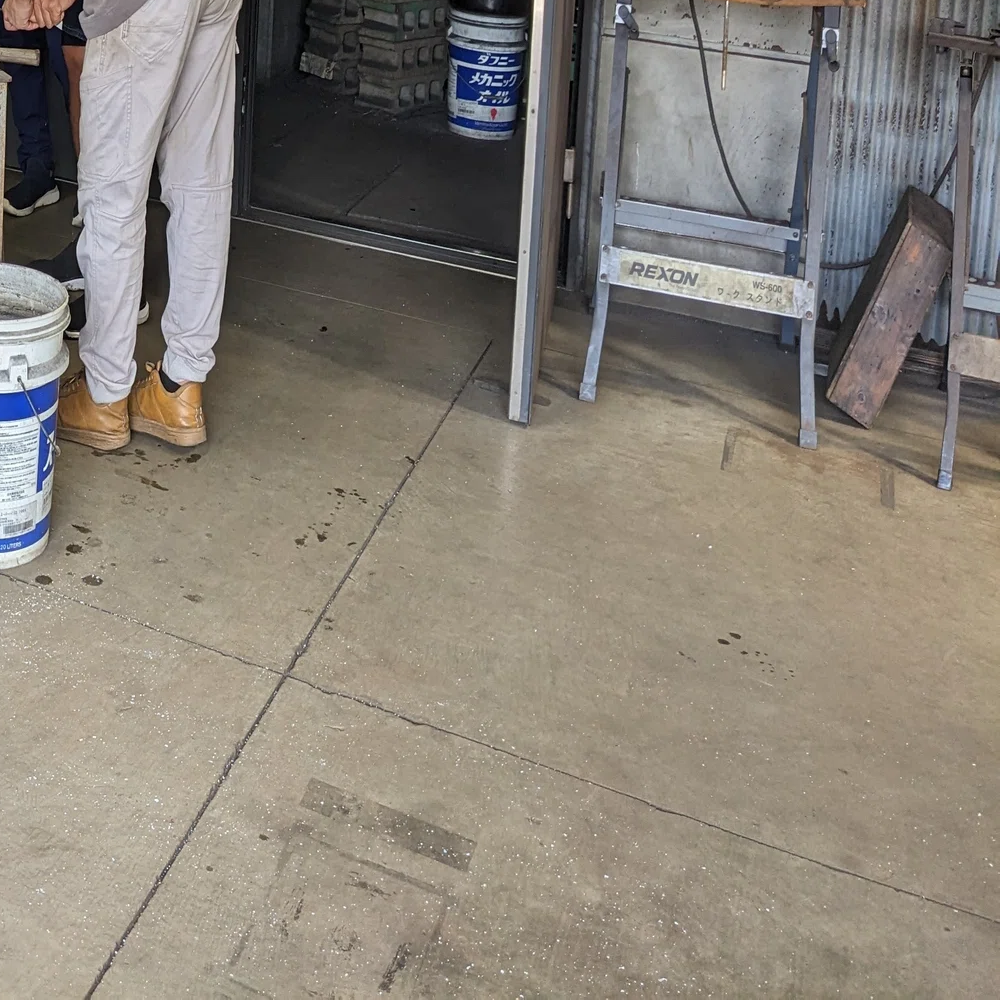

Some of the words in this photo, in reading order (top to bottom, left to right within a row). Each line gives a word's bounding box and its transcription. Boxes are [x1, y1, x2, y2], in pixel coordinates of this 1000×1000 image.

[477, 52, 516, 66] ダフニー
[468, 71, 518, 88] メカニック
[629, 261, 700, 287] REXON
[752, 280, 784, 294] WS-600
